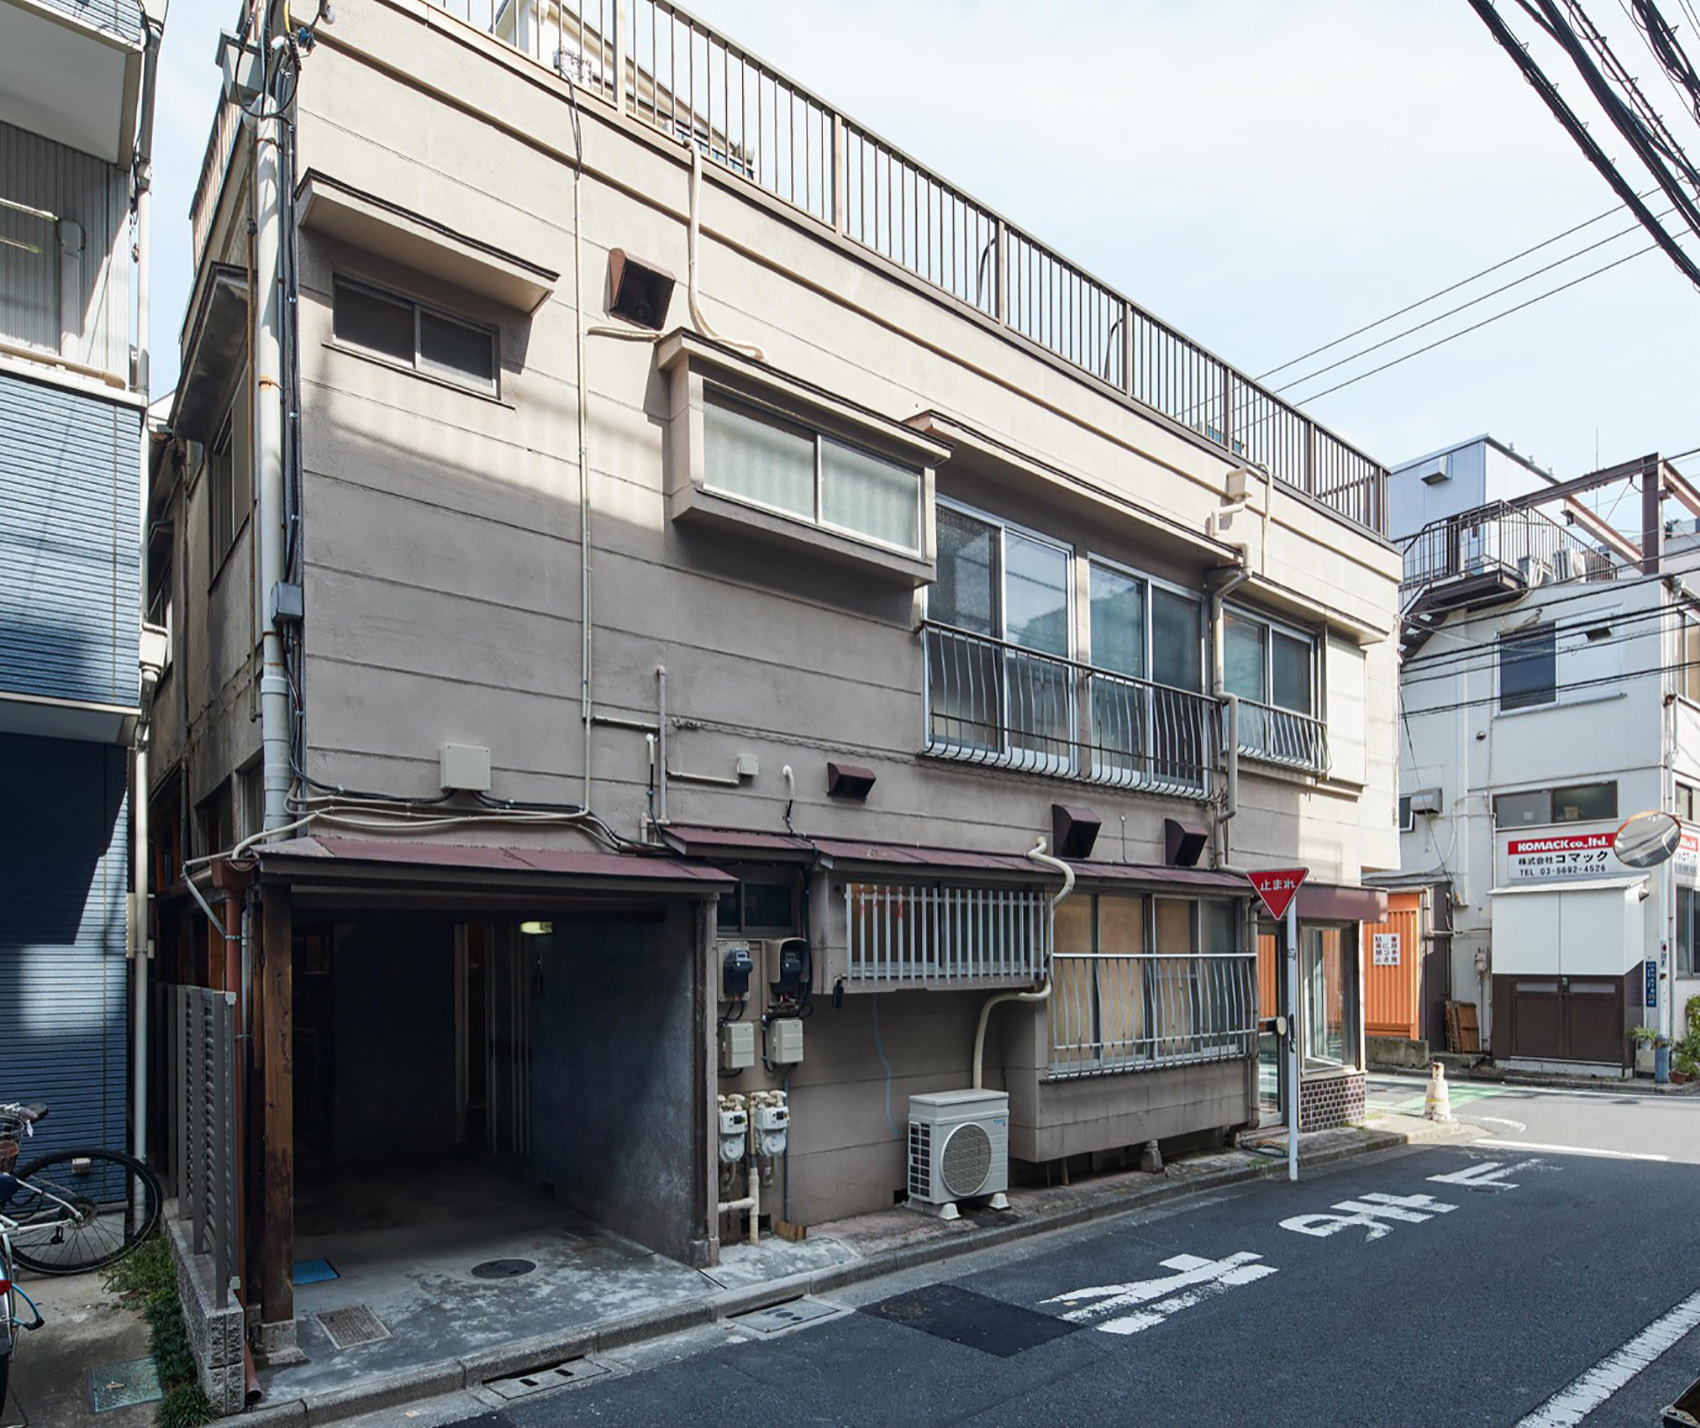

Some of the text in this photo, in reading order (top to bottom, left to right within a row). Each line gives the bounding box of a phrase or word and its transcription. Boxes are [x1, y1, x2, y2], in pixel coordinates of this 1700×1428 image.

[1518, 839, 1569, 852] KOMACK
[1520, 868, 1534, 876] TEL
[1260, 878, 1295, 891] 止まれ
